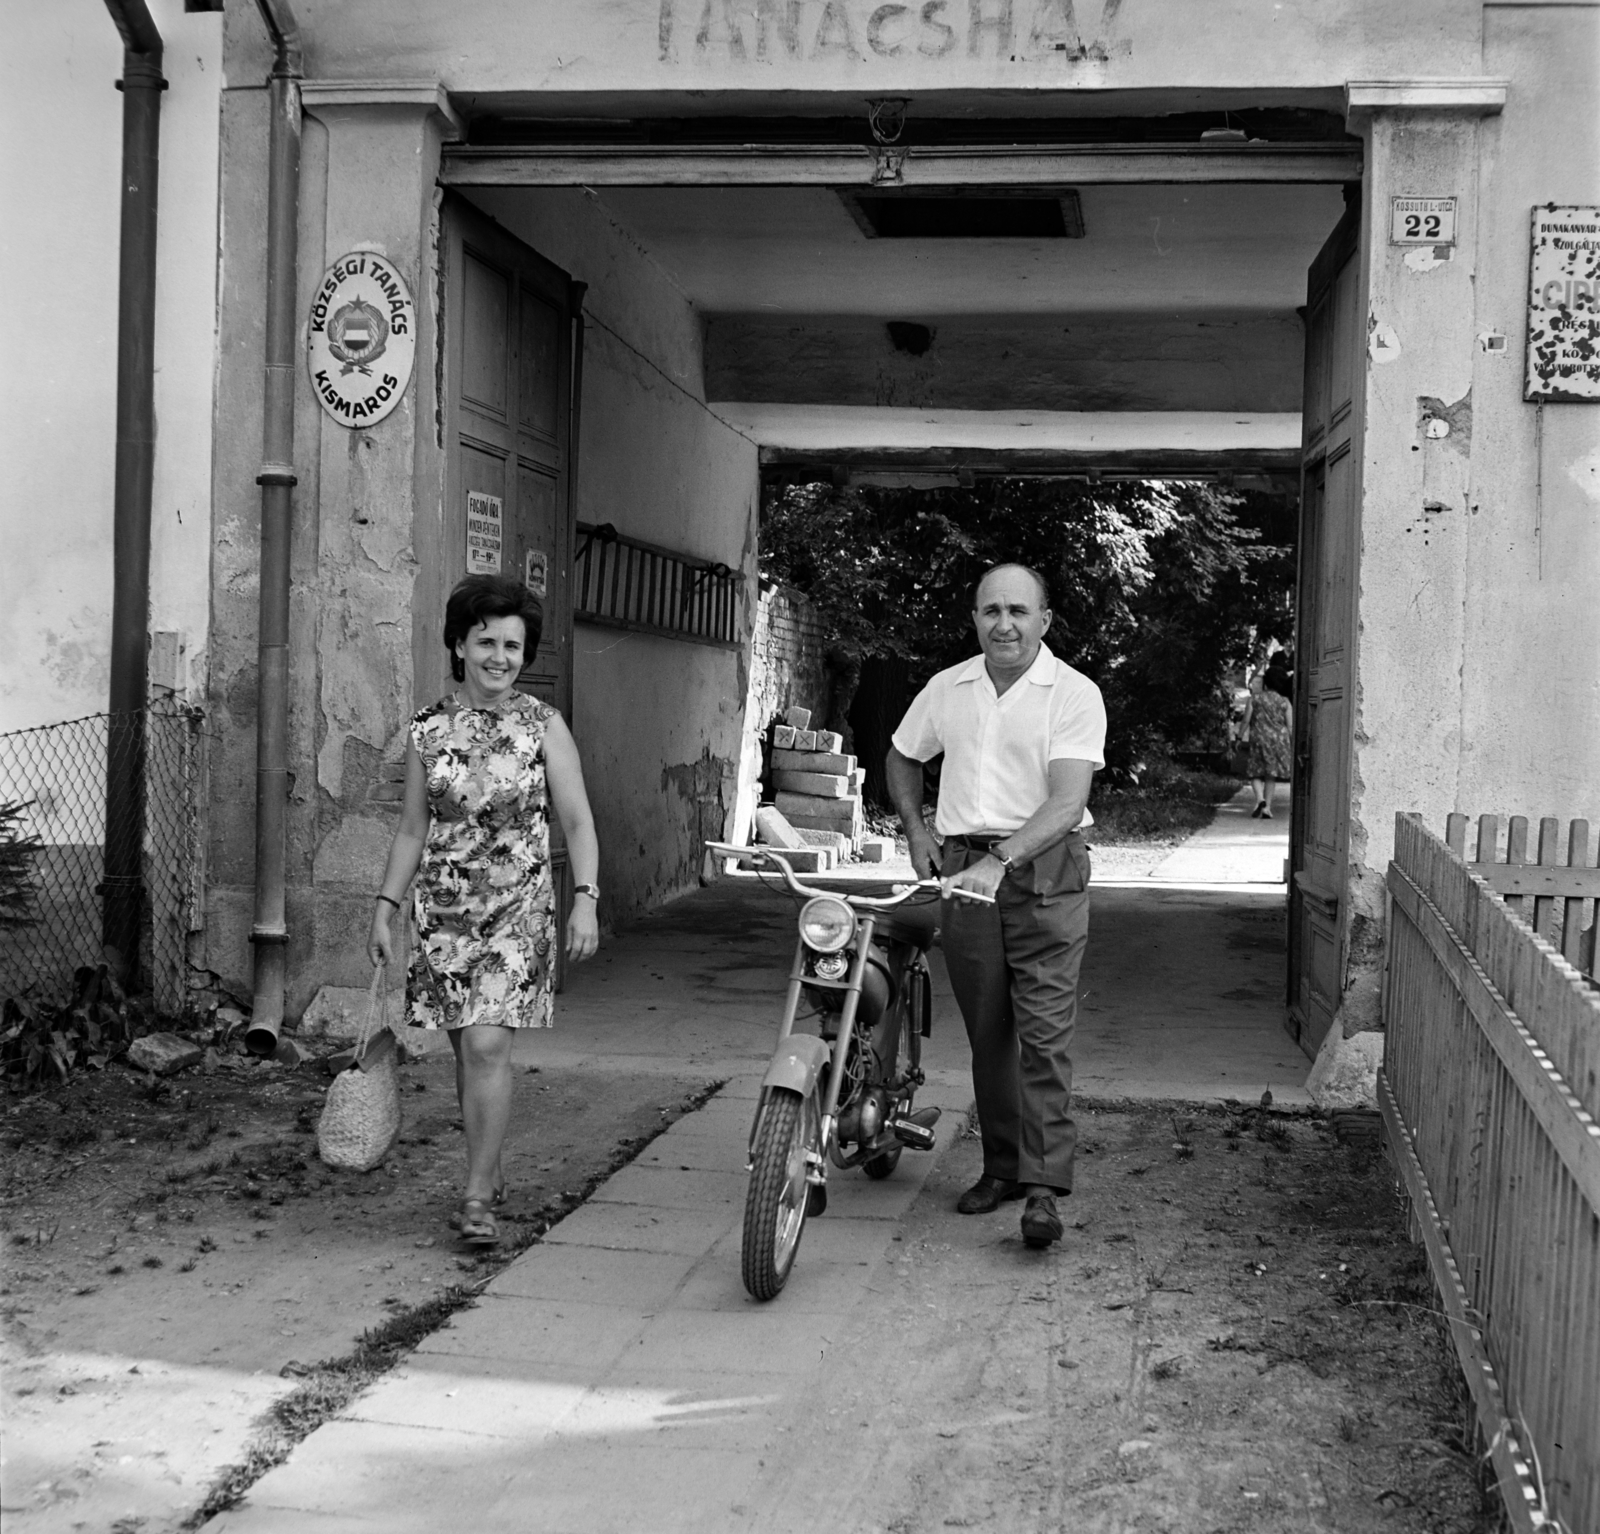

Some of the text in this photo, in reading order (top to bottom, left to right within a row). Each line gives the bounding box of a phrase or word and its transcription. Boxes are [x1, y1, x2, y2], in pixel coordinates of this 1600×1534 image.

[1395, 201, 1428, 212] KOSSUTH
[1404, 214, 1441, 238] 22
[312, 258, 411, 336] KÖZSÉGI TANÁCS
[315, 370, 398, 419] KISMAROS
